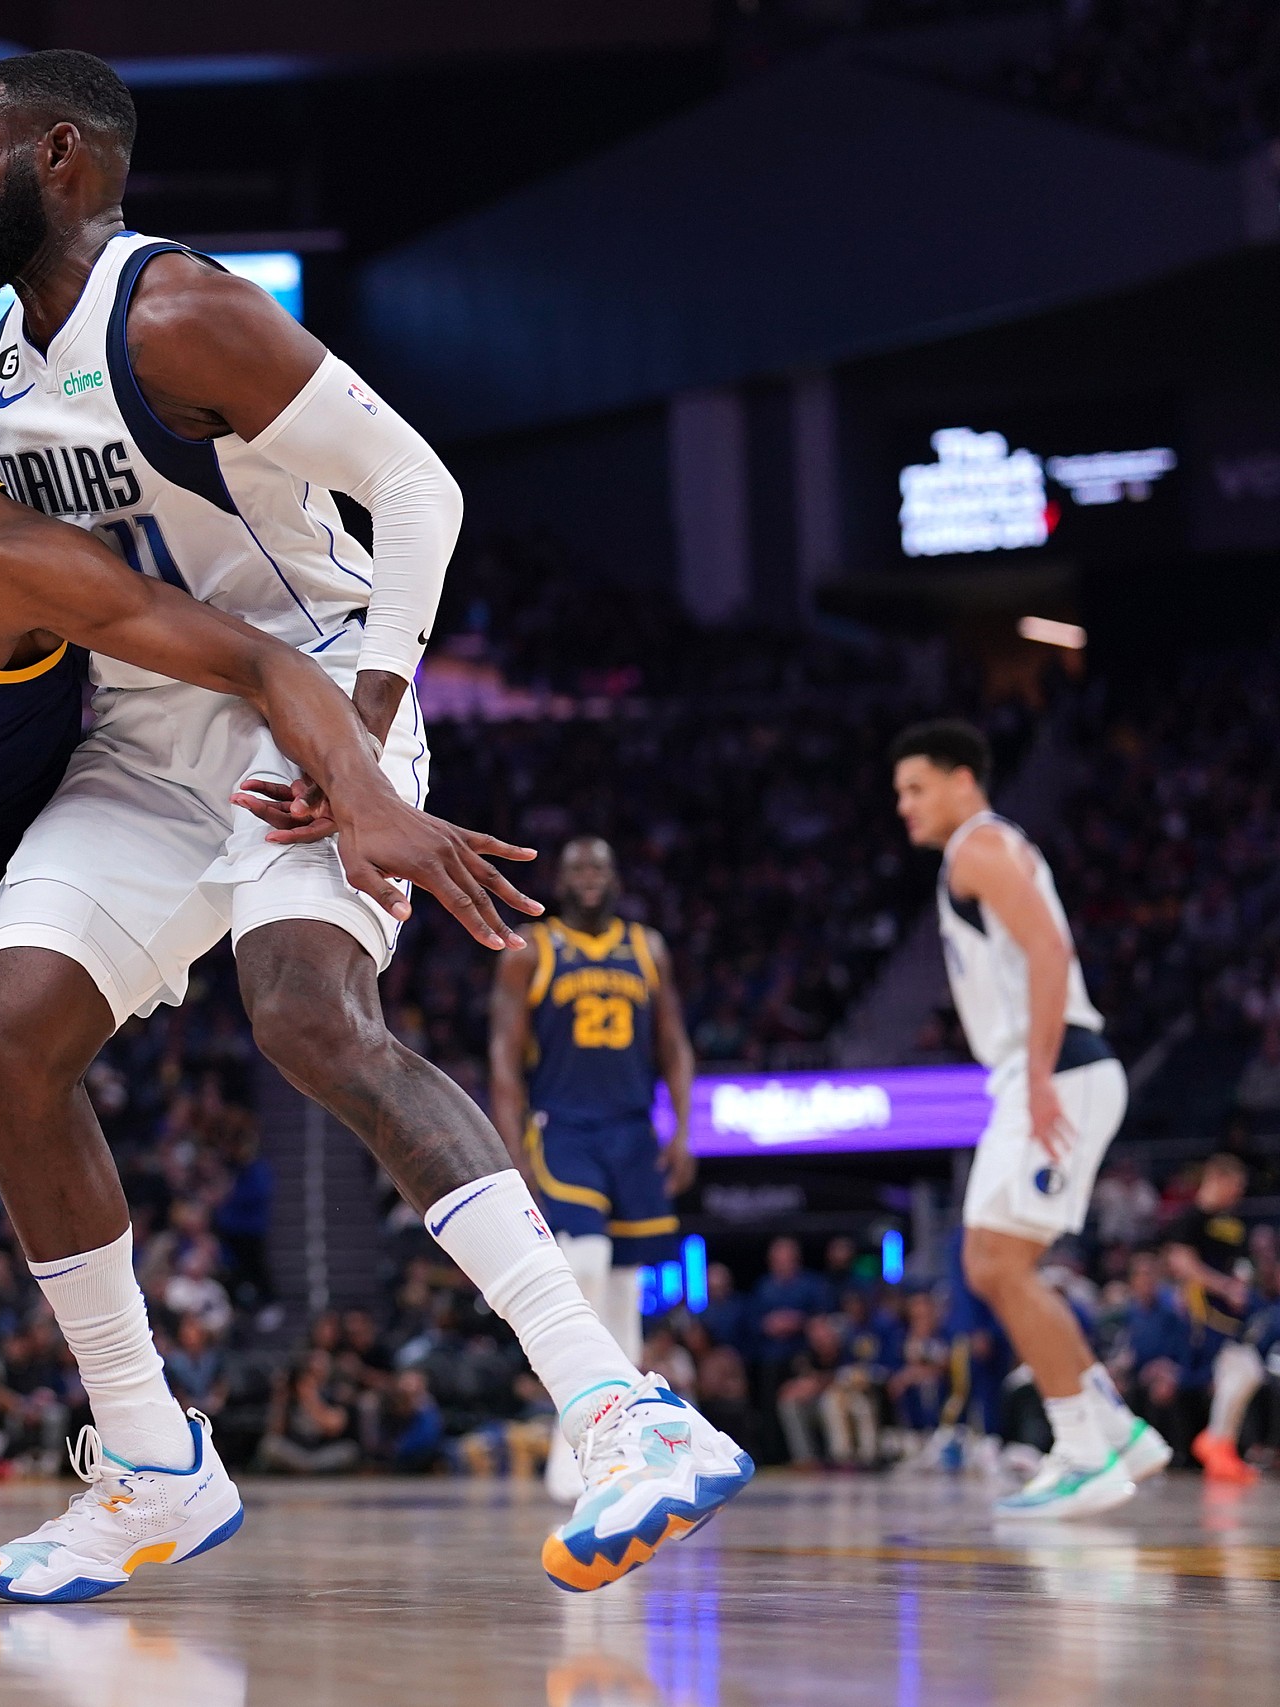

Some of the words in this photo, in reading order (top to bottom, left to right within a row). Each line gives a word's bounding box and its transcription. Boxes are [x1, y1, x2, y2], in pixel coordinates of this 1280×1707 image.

[1, 349, 18, 376] 6
[63, 369, 104, 397] chime
[100, 513, 194, 598] 11
